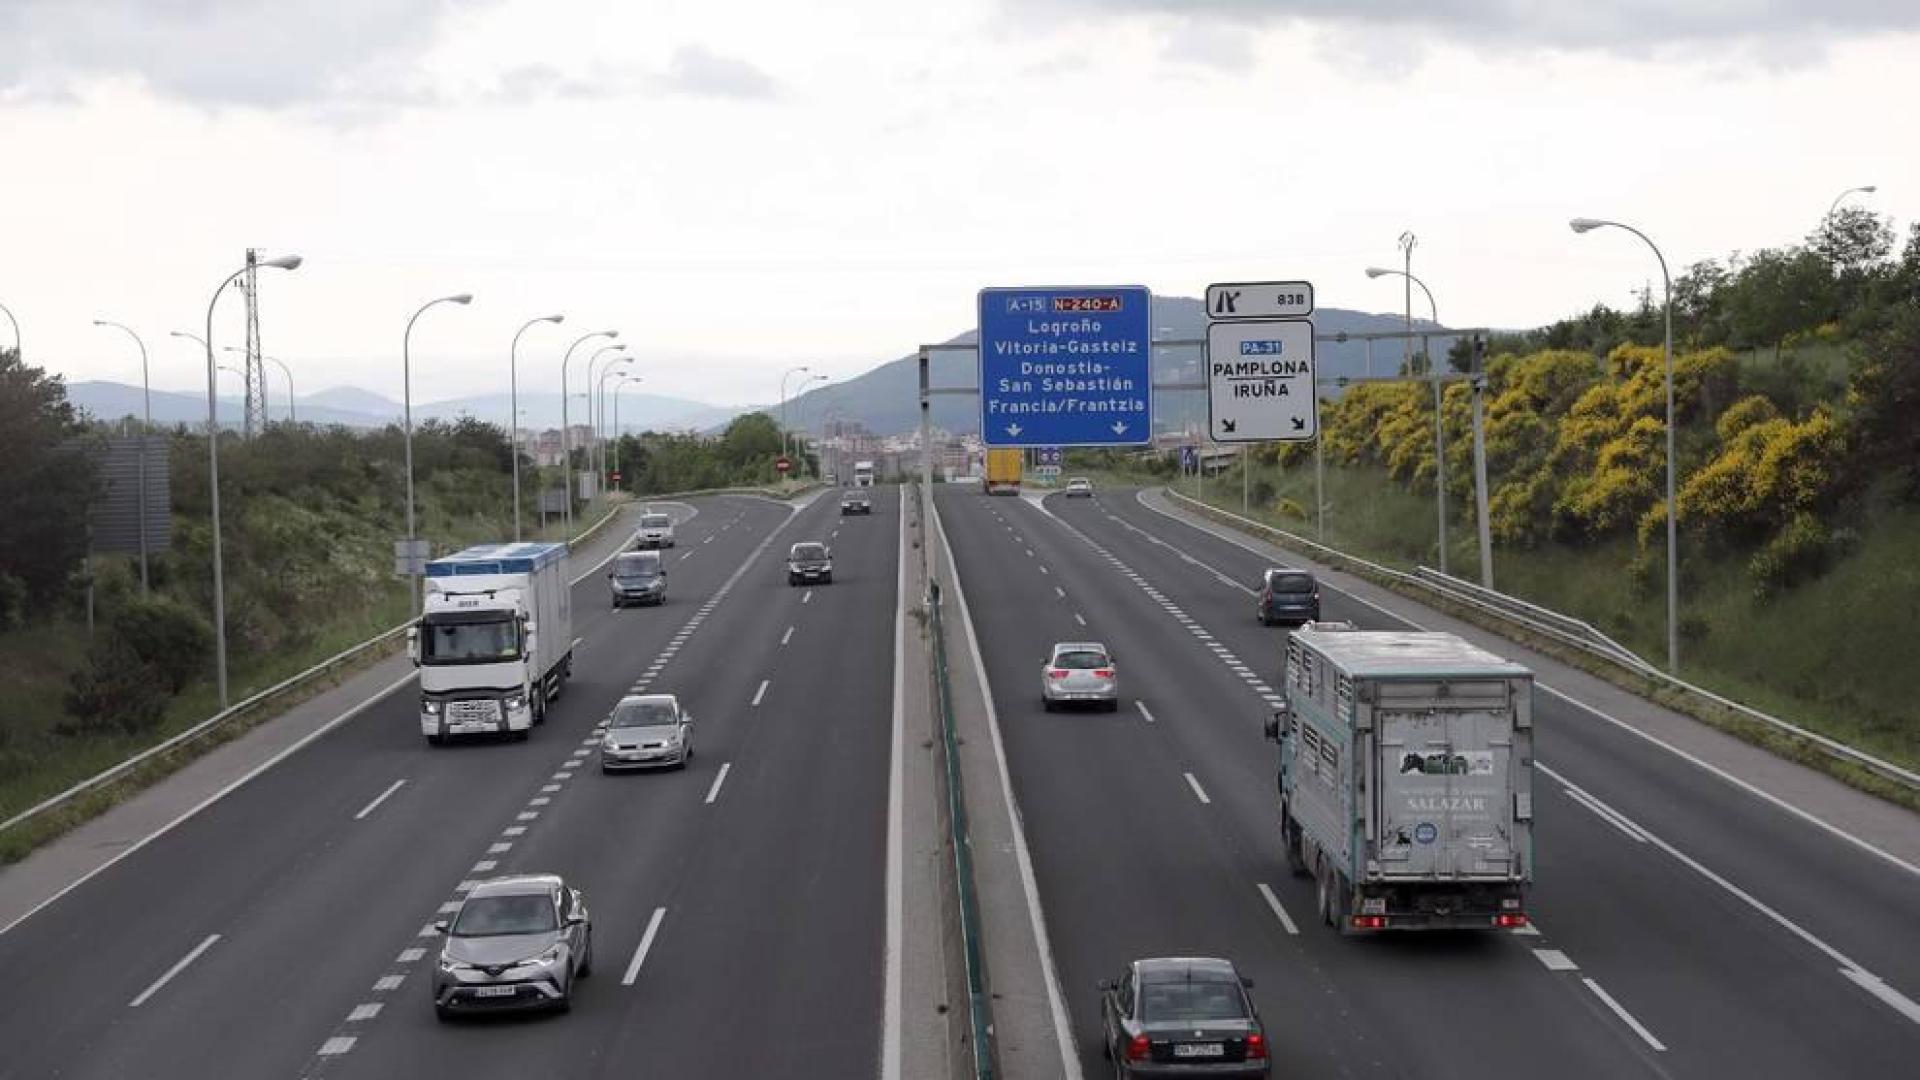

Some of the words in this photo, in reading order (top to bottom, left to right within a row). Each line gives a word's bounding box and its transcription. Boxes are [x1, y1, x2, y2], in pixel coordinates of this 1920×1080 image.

[1010, 299, 1043, 311] A-15
[1055, 299, 1119, 311] N-240-A
[1029, 318, 1102, 336] Logroño
[994, 340, 1137, 355] Vitoria-Gasteiz
[1242, 341, 1280, 354] PA-31
[1022, 361, 1111, 375] Donostia-
[1213, 361, 1309, 376] PAMPLONA
[1000, 378, 1032, 392] San
[1042, 377, 1133, 391] Sebastián
[1234, 380, 1289, 398] IRUÑA
[989, 398, 1145, 414] Francia/Frantzia
[1407, 798, 1487, 811] SALAZAR
